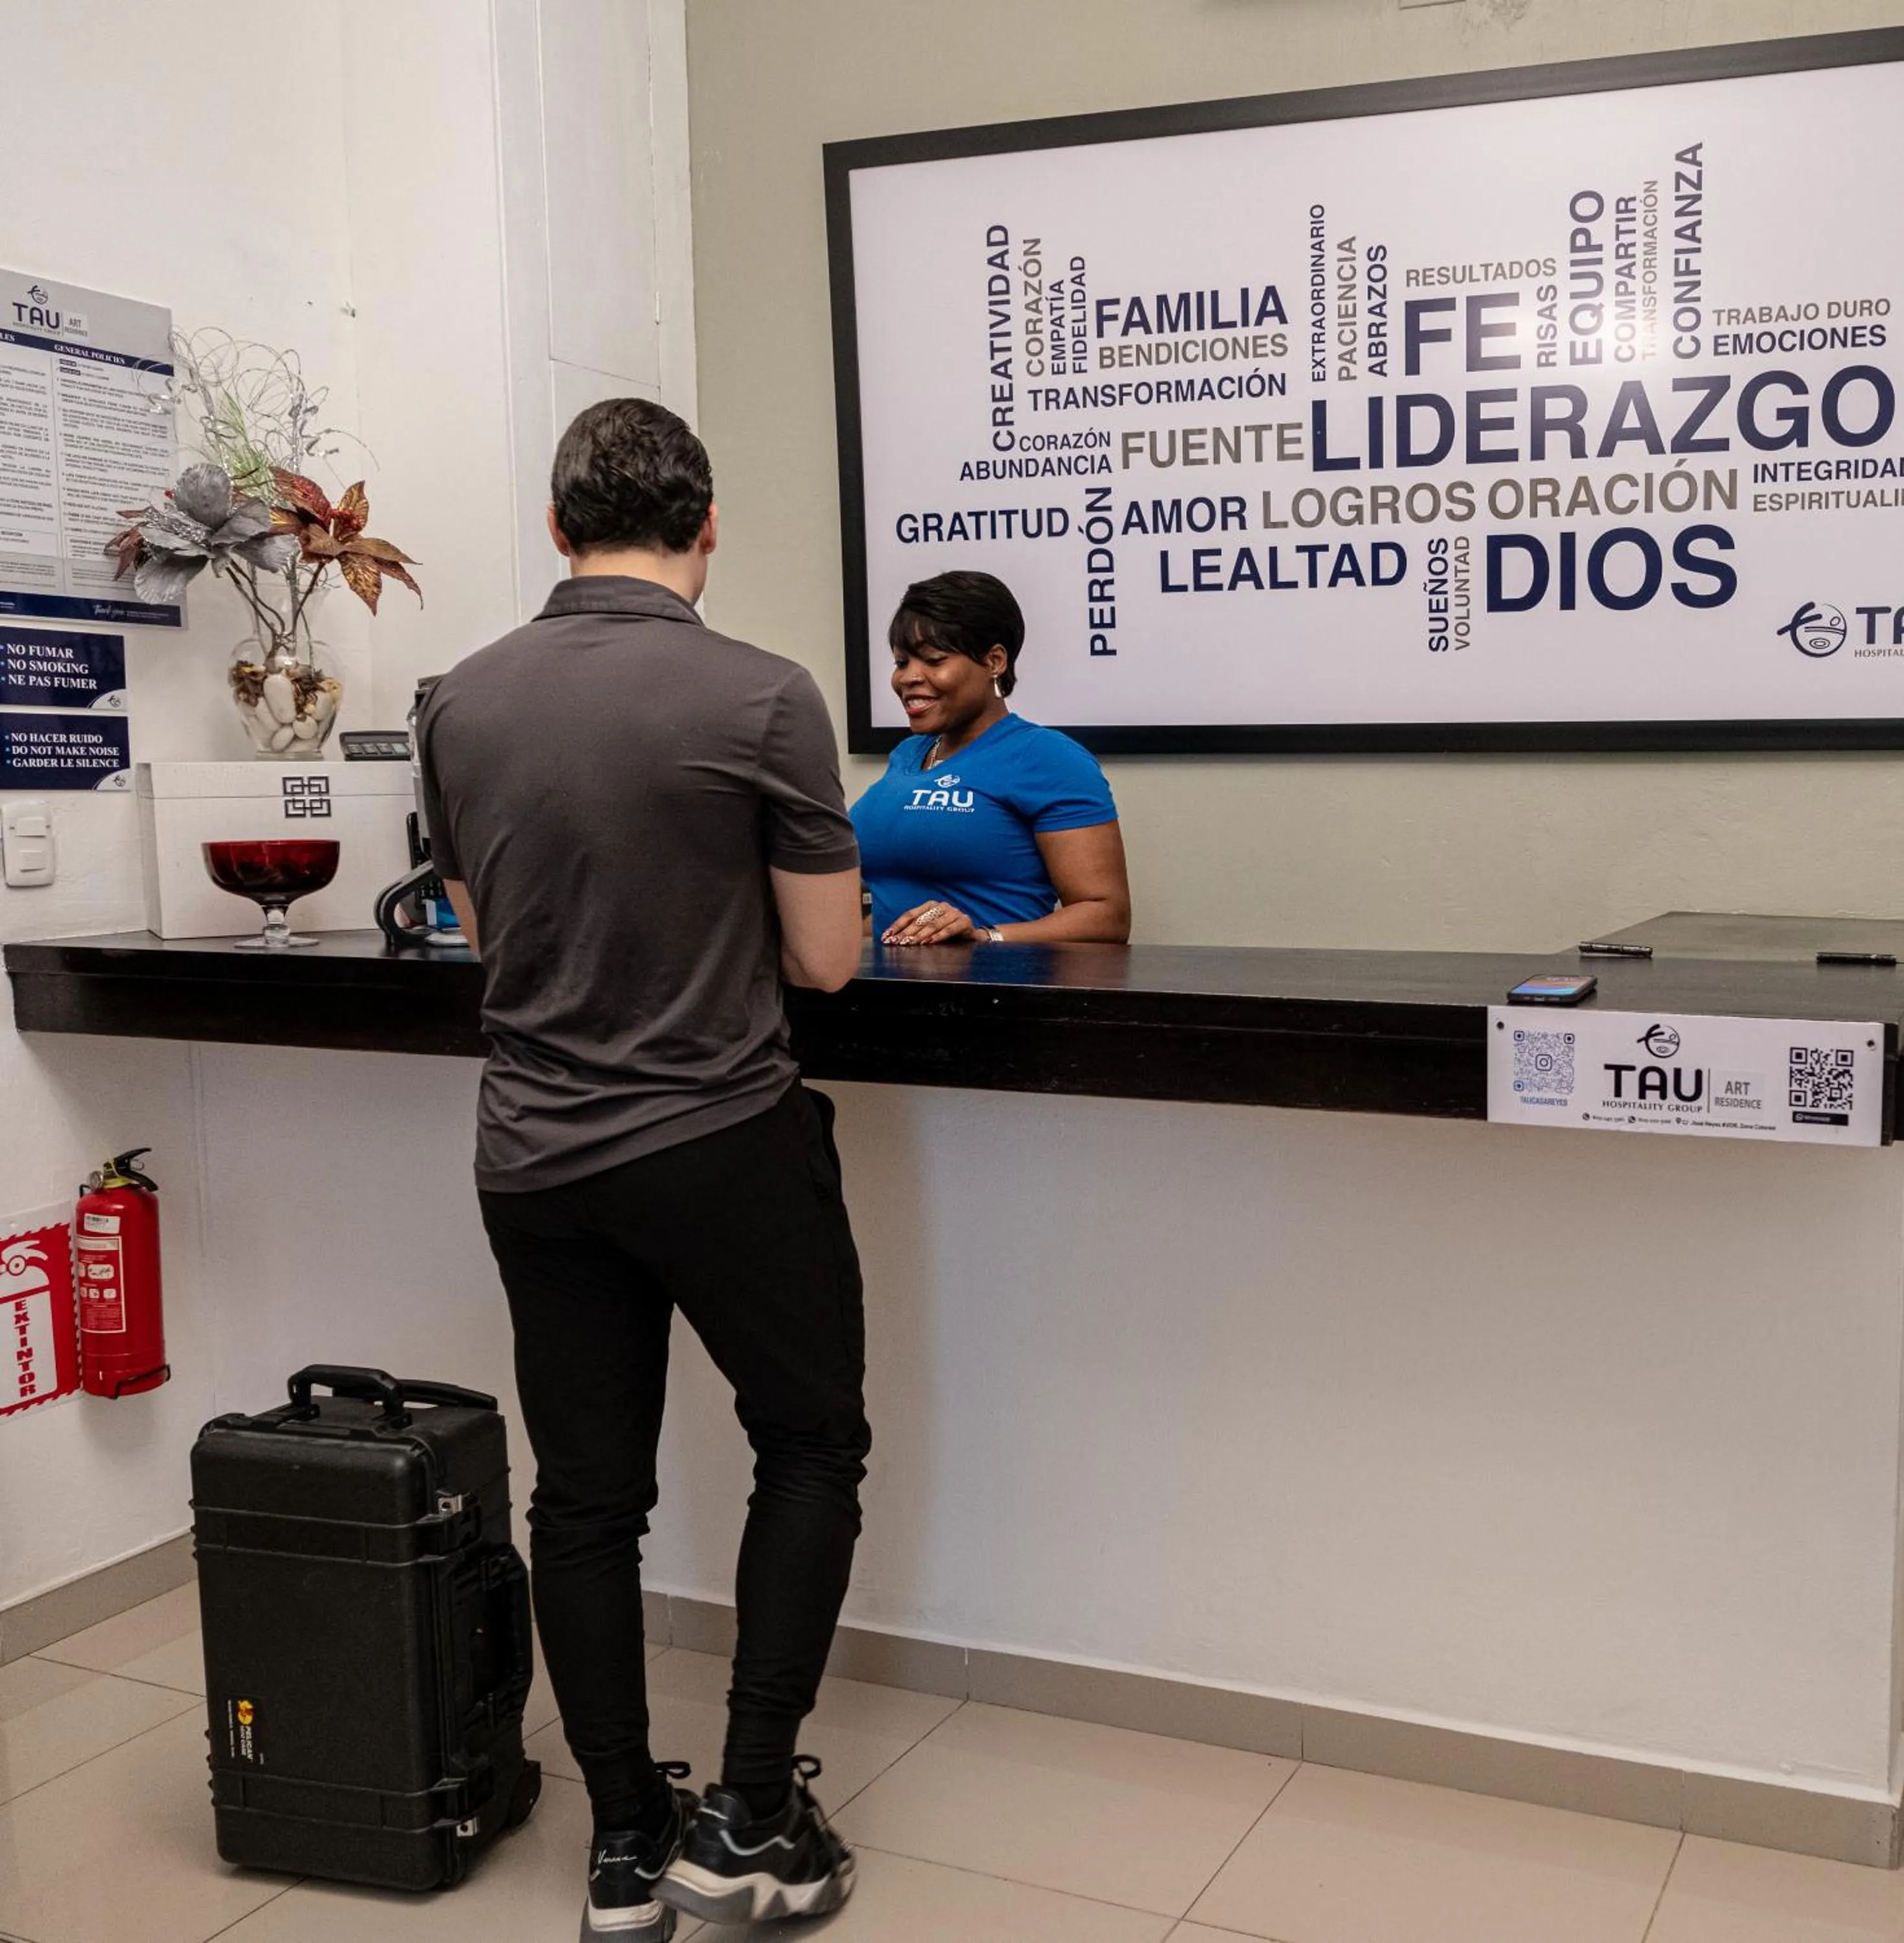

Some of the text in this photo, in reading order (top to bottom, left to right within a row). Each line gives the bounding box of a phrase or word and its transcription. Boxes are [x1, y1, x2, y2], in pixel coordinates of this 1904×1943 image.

[1406, 258, 1556, 288] RESULTADOS
[1639, 180, 1659, 360] TRANSFORMACIÓN
[1673, 142, 1703, 359] CONFIANZA
[1310, 205, 1326, 382] EXTRAORDINARIO
[1569, 190, 1604, 365] EQUIPO
[1615, 196, 1637, 362] COMPARTIR
[12, 302, 60, 329] TAU
[1017, 238, 1045, 377] CORAZÓN
[1045, 280, 1066, 375] EMPATÍA
[1070, 256, 1087, 374] FIDELIDAD
[1096, 285, 1288, 338] FAMILIA
[1337, 236, 1357, 381] PACIENCIA
[1366, 245, 1387, 377] ABRAZOS
[1536, 285, 1557, 368] RISAS
[1712, 299, 1890, 326] TRABAJO DURO
[54, 344, 125, 365] GENERAL POLICIES
[987, 225, 1015, 451] CREATIVIDAD
[1100, 333, 1287, 369] BENDICIONES
[1405, 293, 1521, 376] FE
[1714, 324, 1886, 356] EMOCIONES
[1028, 367, 1286, 411] TRANSFORMACIÓN
[1019, 427, 1110, 452] CORAZÓN
[1312, 365, 1895, 472] LIDERAZGO
[960, 454, 1112, 481] ABUNDANCIA
[1122, 422, 1304, 470] FUENTE
[1488, 459, 1738, 519] ORACIÓN
[1754, 457, 1904, 483] INTEGRIDA
[1122, 496, 1247, 535] AMOR
[1263, 481, 1475, 528] LOGROS
[1754, 488, 1904, 512] ESPIRITUALI
[896, 508, 1069, 543] GRATITUD
[1078, 487, 1116, 656] PERDÓN
[1161, 541, 1407, 593] LEALTAD
[1487, 525, 1737, 613] DIOS
[1423, 538, 1449, 652] SUEÑOS
[1455, 536, 1470, 650] VOLUNTAD
[6, 644, 74, 659] NO FUMAR
[7, 659, 89, 674] NO SMOKING
[8, 674, 97, 690] NE PAS FUMER
[11, 733, 102, 743] NO HACER RUIDO
[12, 746, 119, 756] DO NOT MAKE NOISE
[12, 759, 120, 768] GARDER LE SILENCE
[912, 790, 974, 808] TAU
[1604, 1063, 1703, 1102] TAU
[1714, 1096, 1762, 1110] RESIDENCE
[1724, 1080, 1751, 1095] ART
[1602, 1100, 1703, 1113] HOSPITALITY GROUP
[14, 1300, 36, 1397] EXTINTOR
